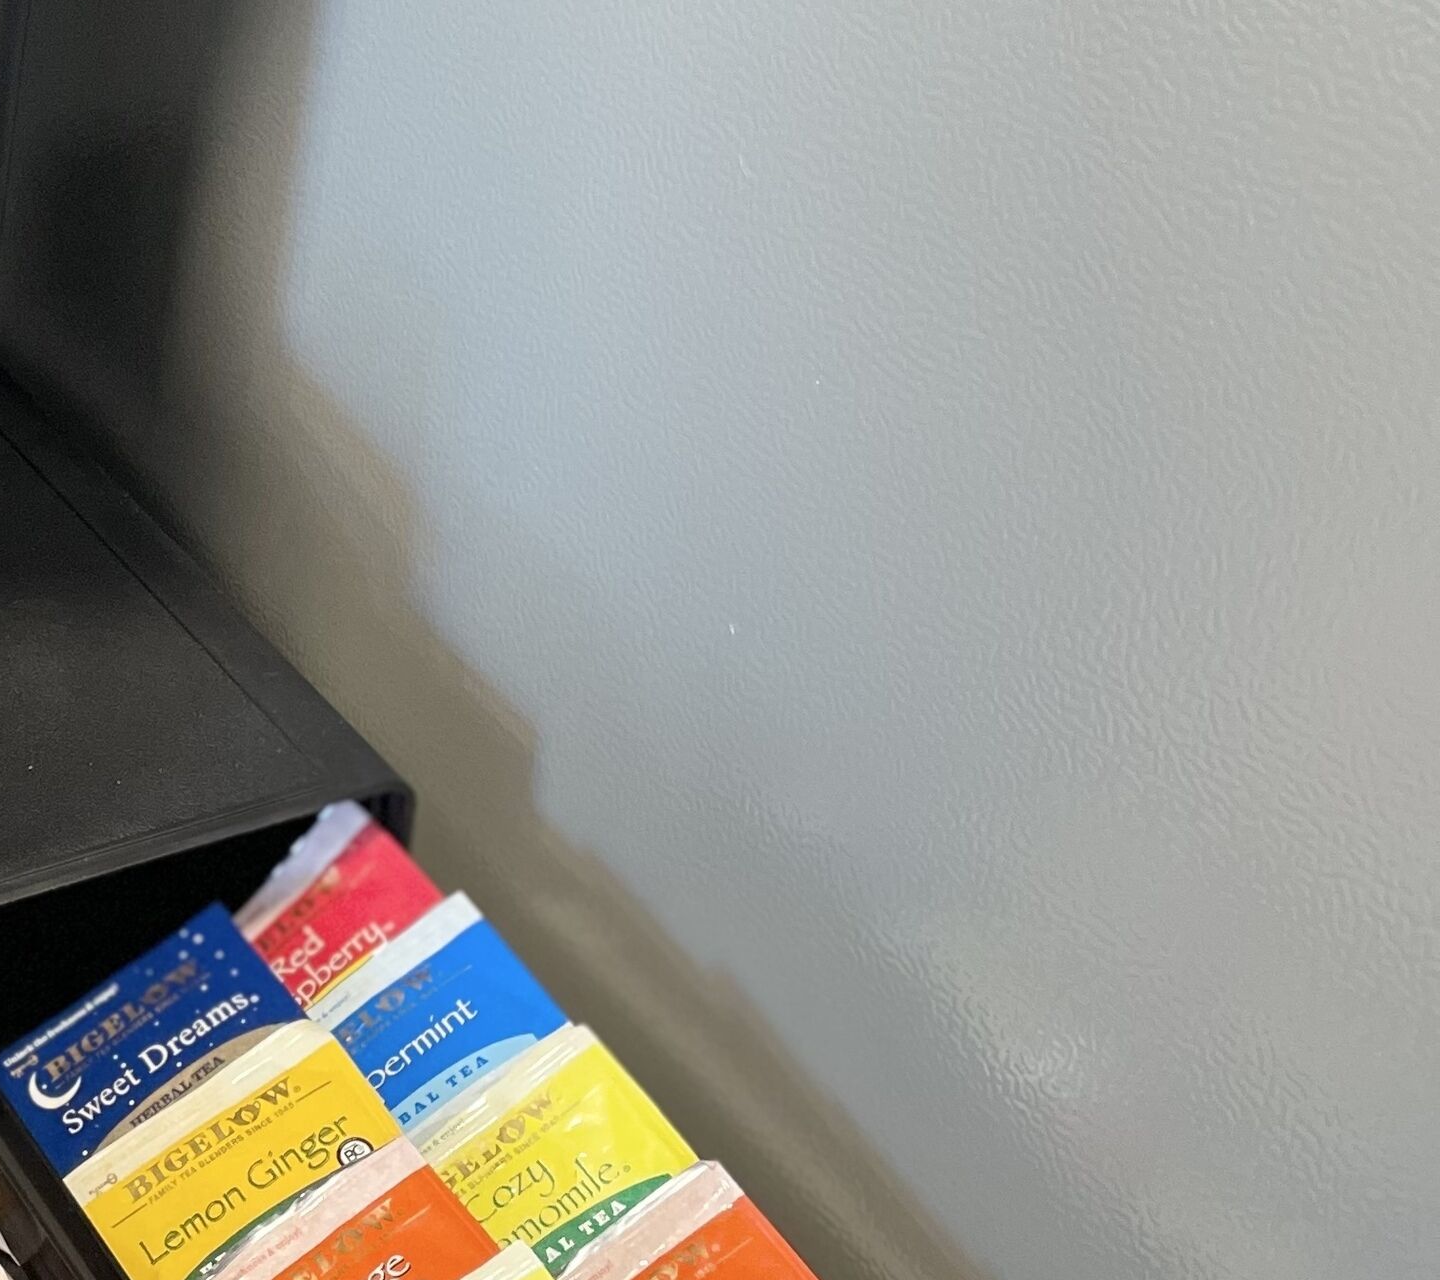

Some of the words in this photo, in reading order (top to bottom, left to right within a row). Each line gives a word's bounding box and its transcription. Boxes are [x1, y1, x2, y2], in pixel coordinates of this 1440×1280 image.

[270, 925, 325, 983] Red
[43, 959, 197, 1082] BIGELOW
[366, 998, 478, 1089] permint
[62, 1068, 141, 1136] Sweet
[138, 991, 249, 1074] Dreams
[130, 1081, 191, 1129] HERBAL
[191, 1055, 226, 1085] TEA
[397, 1090, 439, 1126] BAL
[445, 1054, 489, 1088] TEA
[123, 1076, 291, 1203] BIGELOW
[179, 1166, 197, 1181] TEA
[247, 1116, 273, 1136] SINCE
[138, 1185, 247, 1266] Lemon
[247, 1115, 348, 1191] Ginger
[465, 1160, 555, 1223] Cozy
[578, 1200, 627, 1235] TEA
